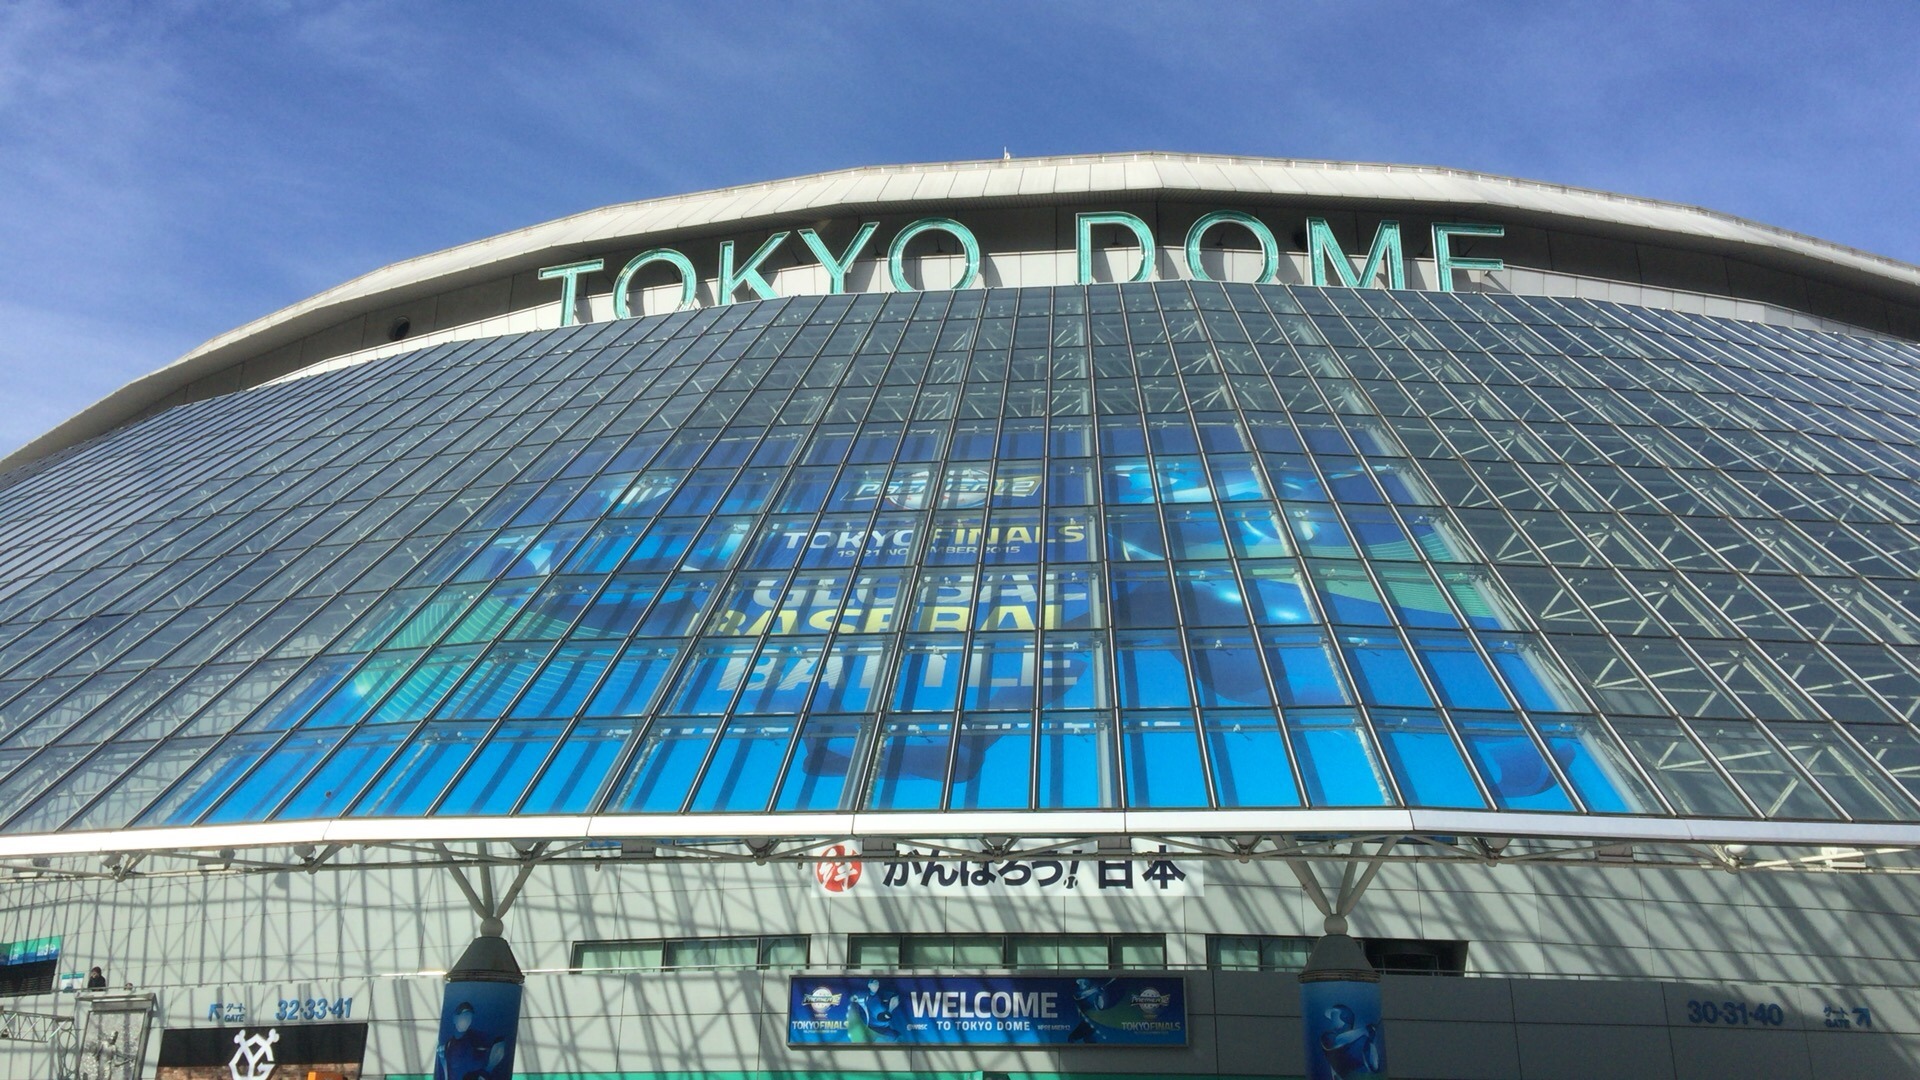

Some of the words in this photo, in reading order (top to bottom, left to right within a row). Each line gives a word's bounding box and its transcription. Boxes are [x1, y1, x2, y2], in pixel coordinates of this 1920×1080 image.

[538, 218, 980, 326] TOKYO
[1073, 210, 1505, 292] DOME
[783, 528, 920, 550] TOKYO
[932, 525, 1084, 547] FINALS
[752, 574, 1086, 607] GLOBAL
[716, 645, 1077, 690] BATTLE
[911, 991, 1058, 1018] WELCOME
[225, 1014, 244, 1023] GATE
[937, 1021, 951, 1031] TO
[956, 1021, 993, 1031] TOKYO
[997, 1021, 1031, 1031] DOME
